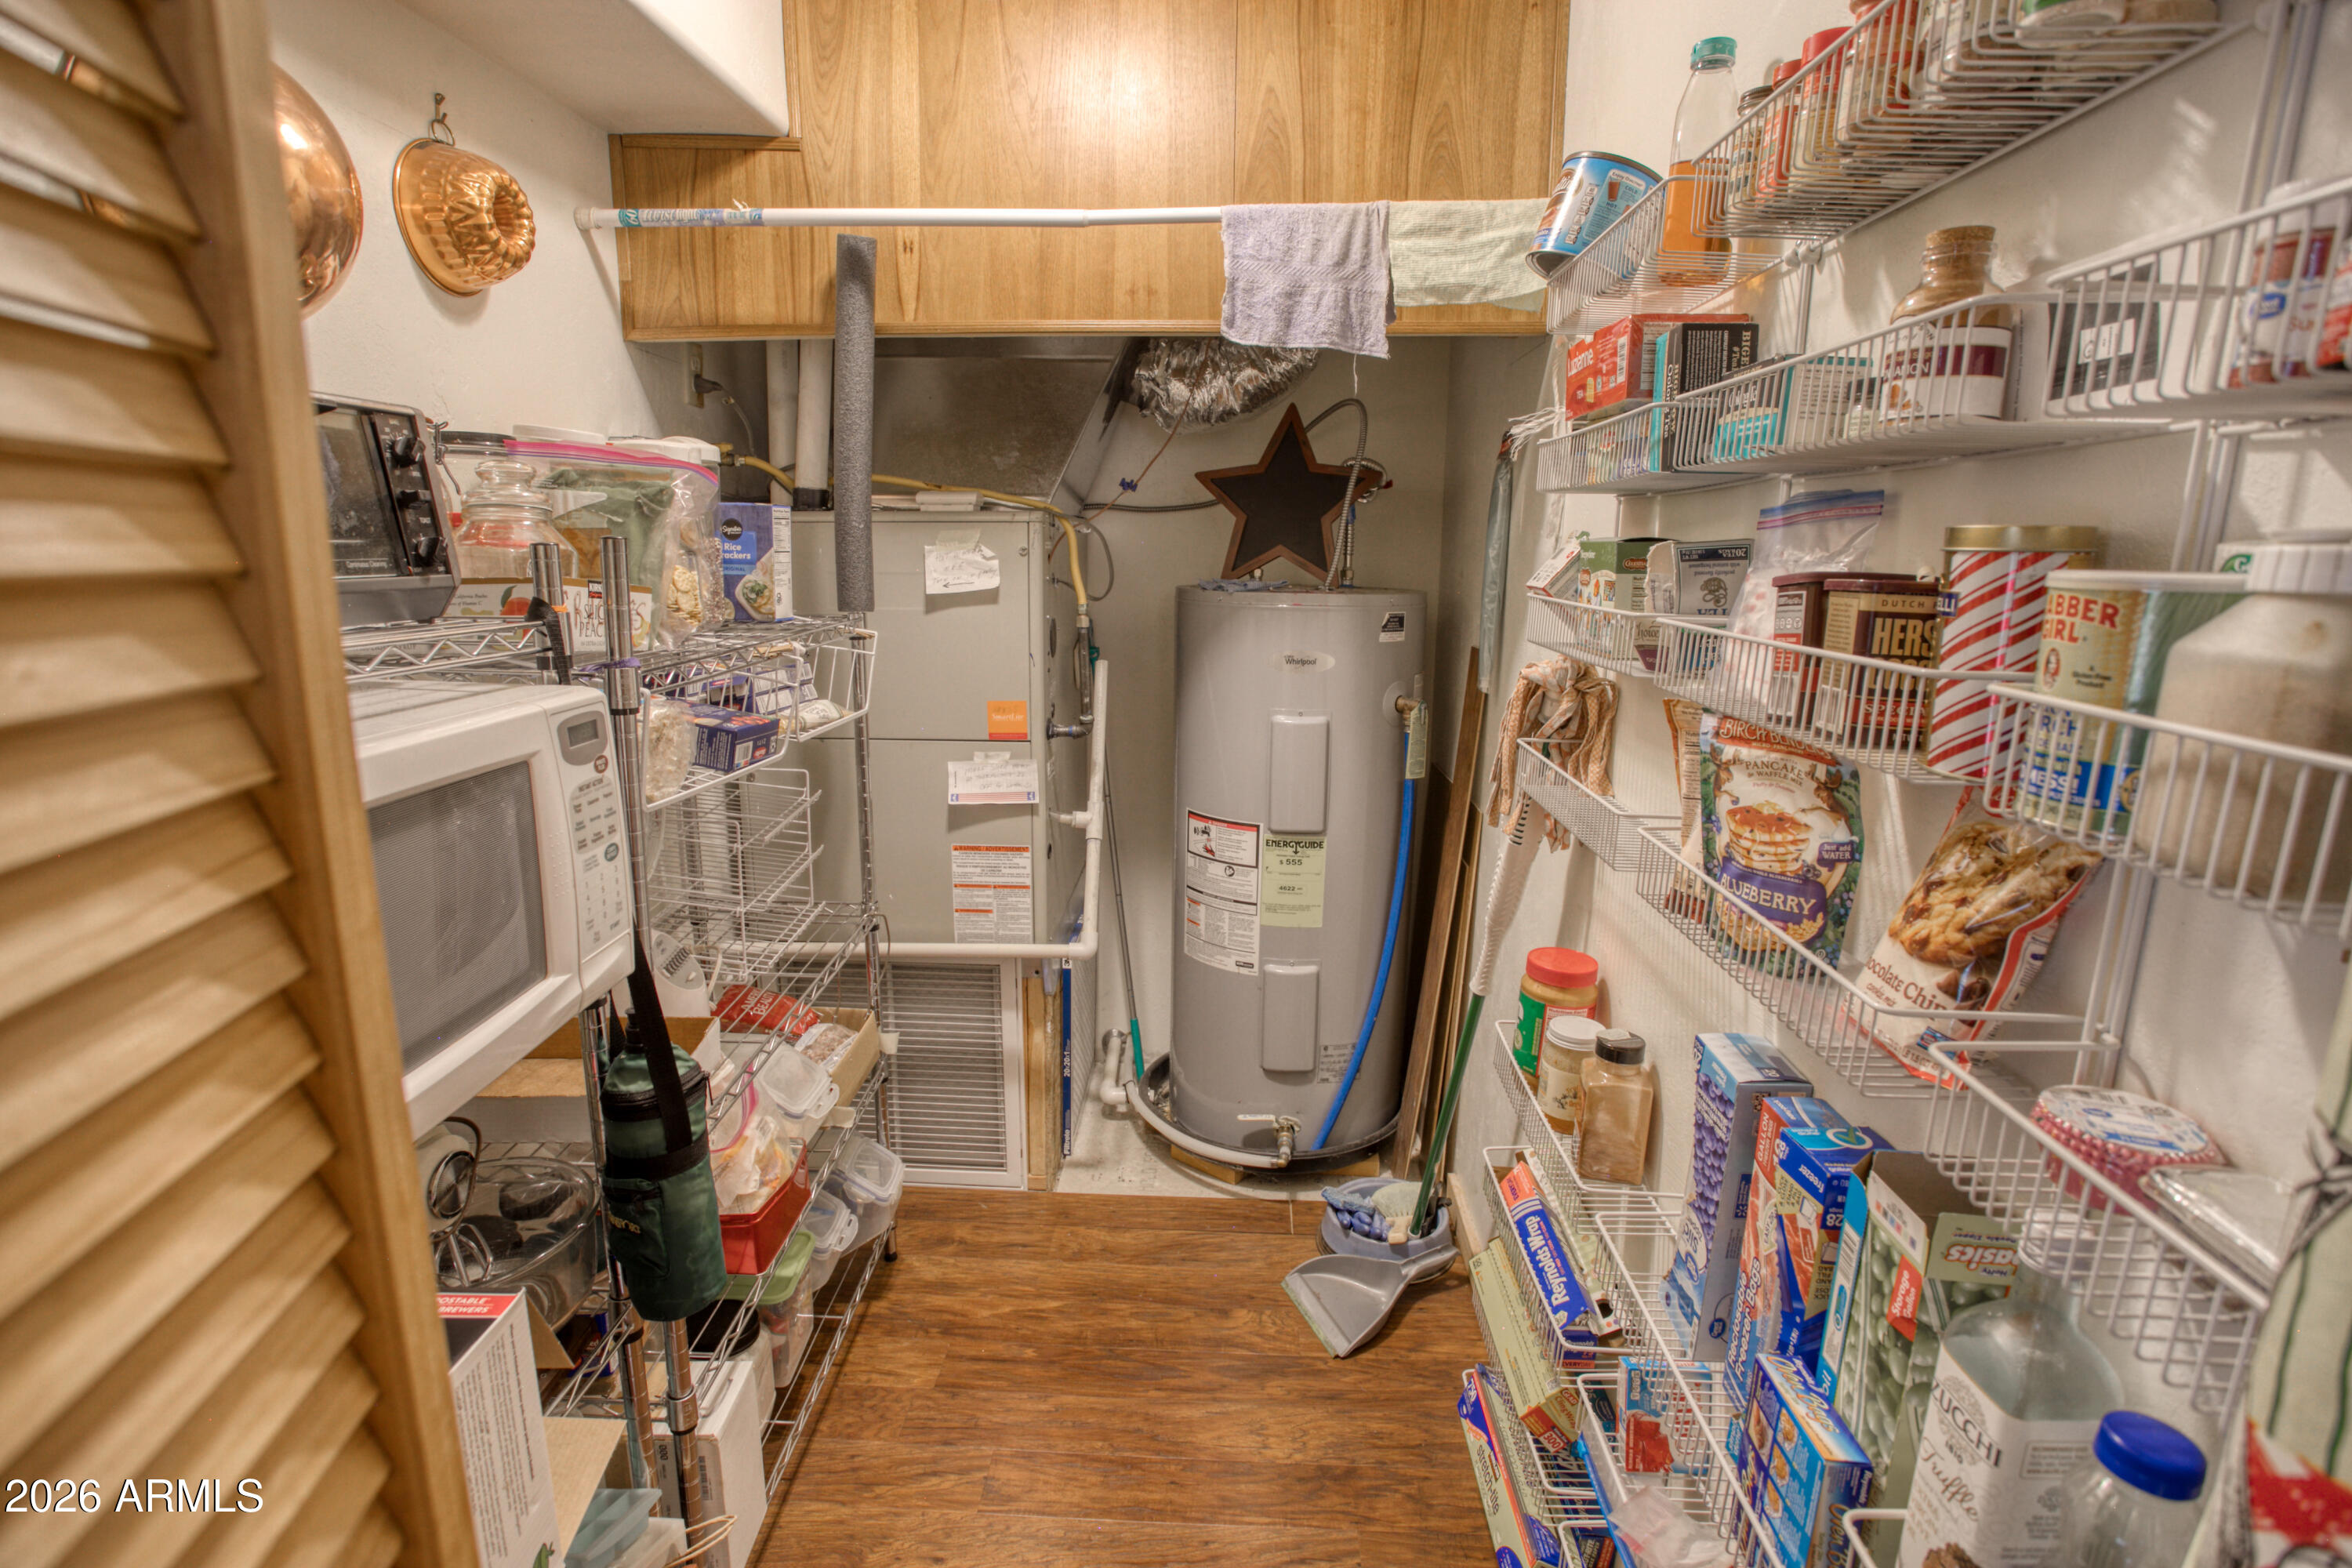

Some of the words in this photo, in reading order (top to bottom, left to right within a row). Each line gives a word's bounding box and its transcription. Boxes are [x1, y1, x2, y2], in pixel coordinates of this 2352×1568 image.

[724, 543, 742, 551] Rice
[1882, 599, 1925, 608] DUTCH
[2045, 593, 2121, 629] ABBER
[1871, 617, 1935, 657] HERS
[1285, 658, 1317, 666] Whirlpool
[1864, 704, 1926, 716] SPECIA
[1719, 719, 1766, 740] BIRCH
[1745, 760, 1803, 779] PANCAKE
[1755, 771, 1789, 781] WAFFLE
[1790, 775, 1803, 786] MIX
[1265, 839, 1324, 850] ENERGYGUIDE
[1821, 851, 1851, 860] WATER
[1719, 872, 1817, 916] BLUEBERRY
[1865, 982, 1886, 1000] cookie
[1866, 956, 1903, 993] ocolate
[1756, 1112, 1769, 1162] GALLON
[1798, 1164, 1825, 1194] freezer
[1526, 1214, 1541, 1252] Wrap
[1537, 1246, 1570, 1308] Reynolds
[1891, 1270, 1910, 1317] Storage
[1728, 1271, 1748, 1367] Reclosable
[1735, 1306, 1752, 1382] Freezer
[1745, 1257, 1762, 1308] Bags
[1903, 1287, 1916, 1319] Gallon
[1932, 1380, 2002, 1467] ZUCCHI
[1543, 1432, 1562, 1450] 300
[1477, 1444, 1501, 1516] stretch-tite
[1922, 1436, 1980, 1523] Truffle
